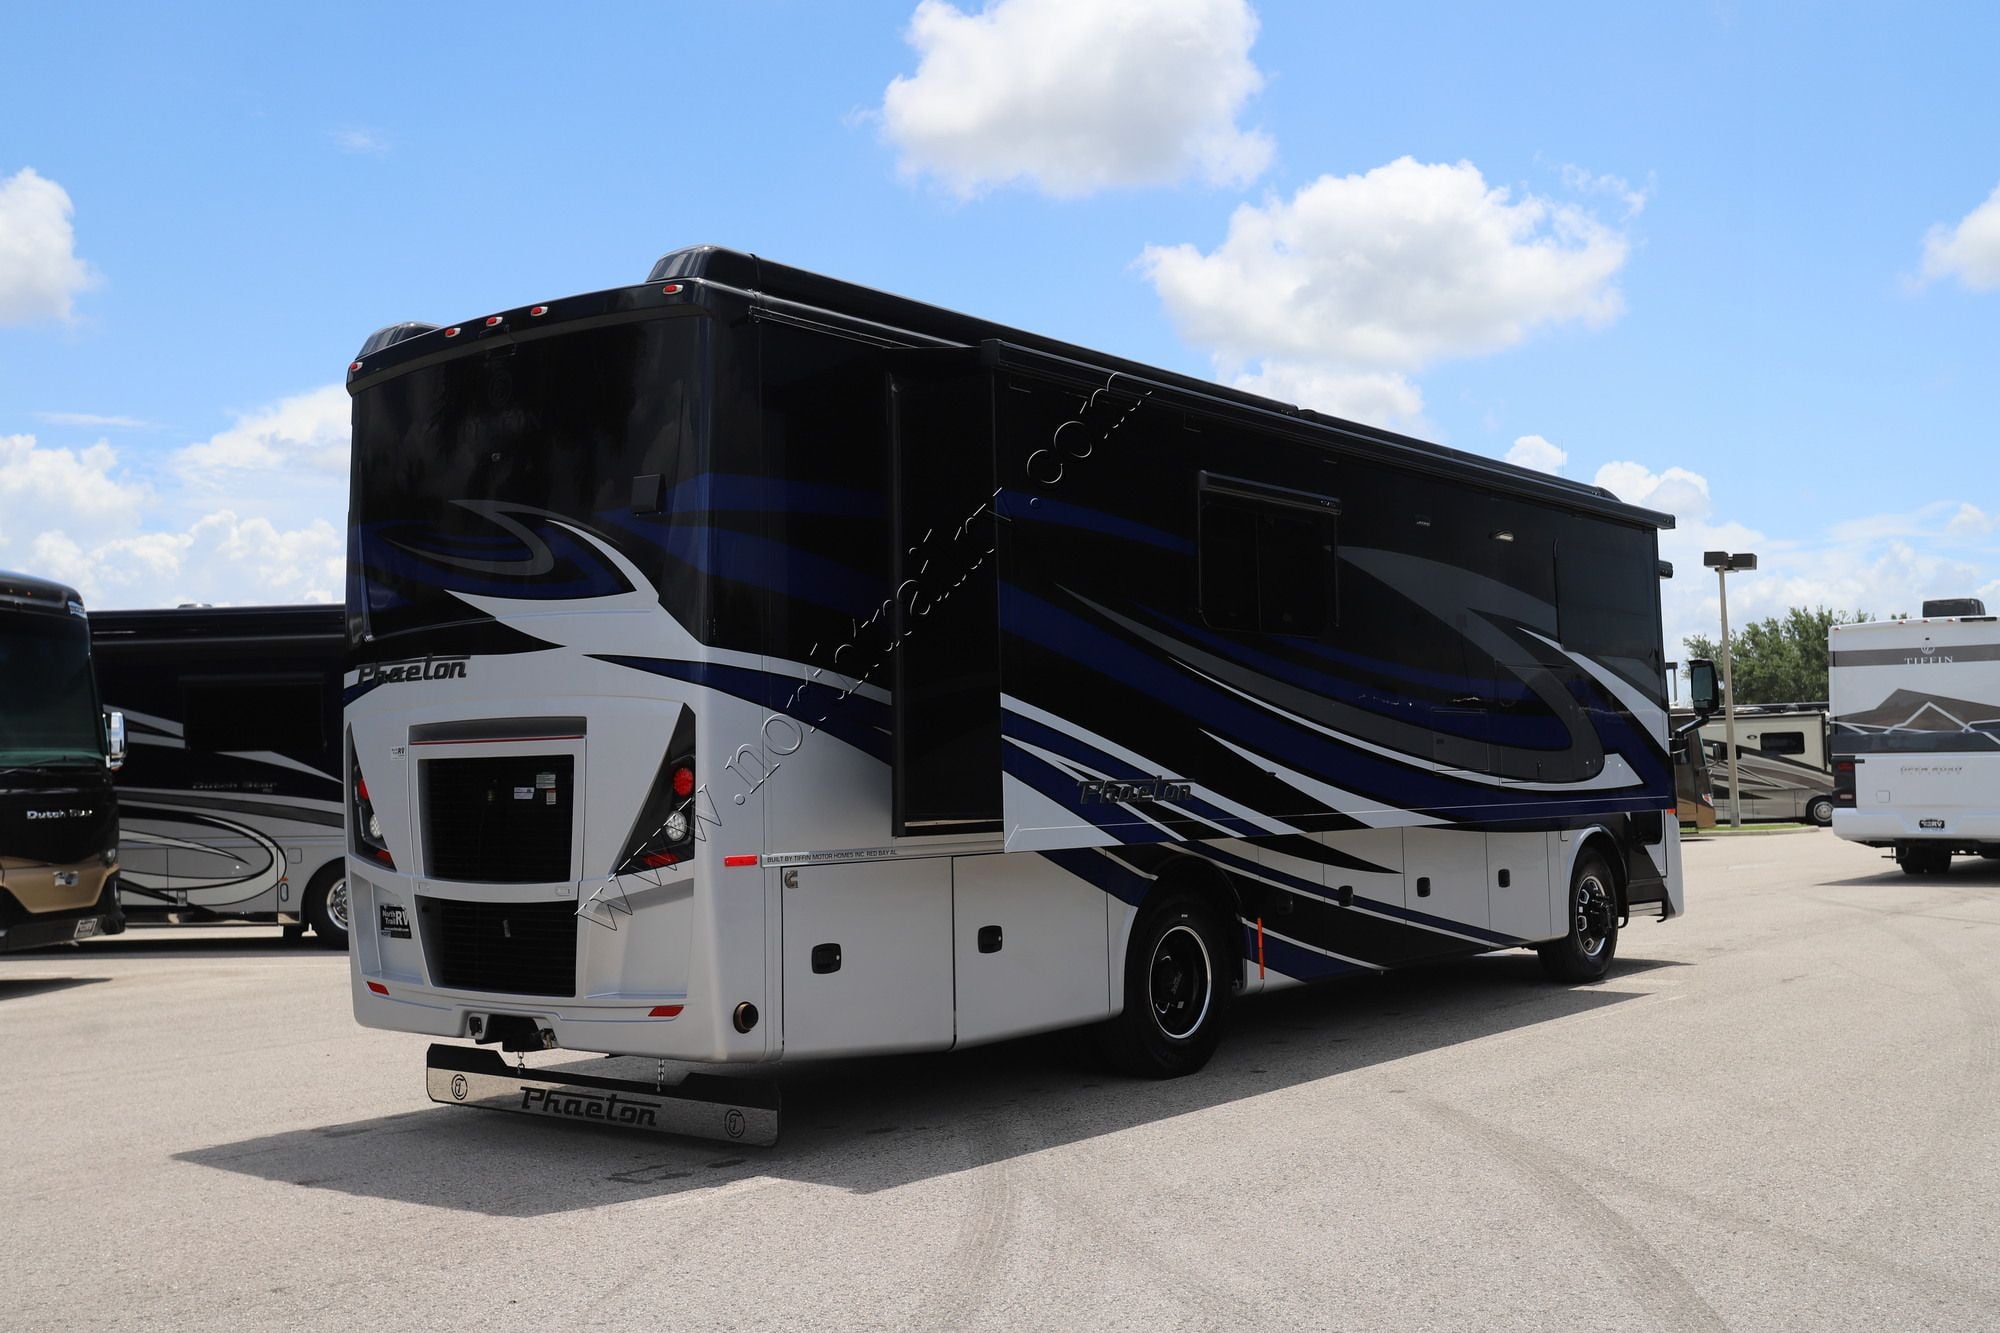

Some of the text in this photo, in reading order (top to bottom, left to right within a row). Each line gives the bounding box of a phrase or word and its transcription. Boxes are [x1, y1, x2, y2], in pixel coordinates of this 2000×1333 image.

[355, 653, 471, 685] Phaeton
[1077, 775, 1199, 805] Phaeton
[27, 809, 65, 820] Dutch
[395, 910, 410, 926] RV
[520, 1086, 662, 1127] Phaeton
